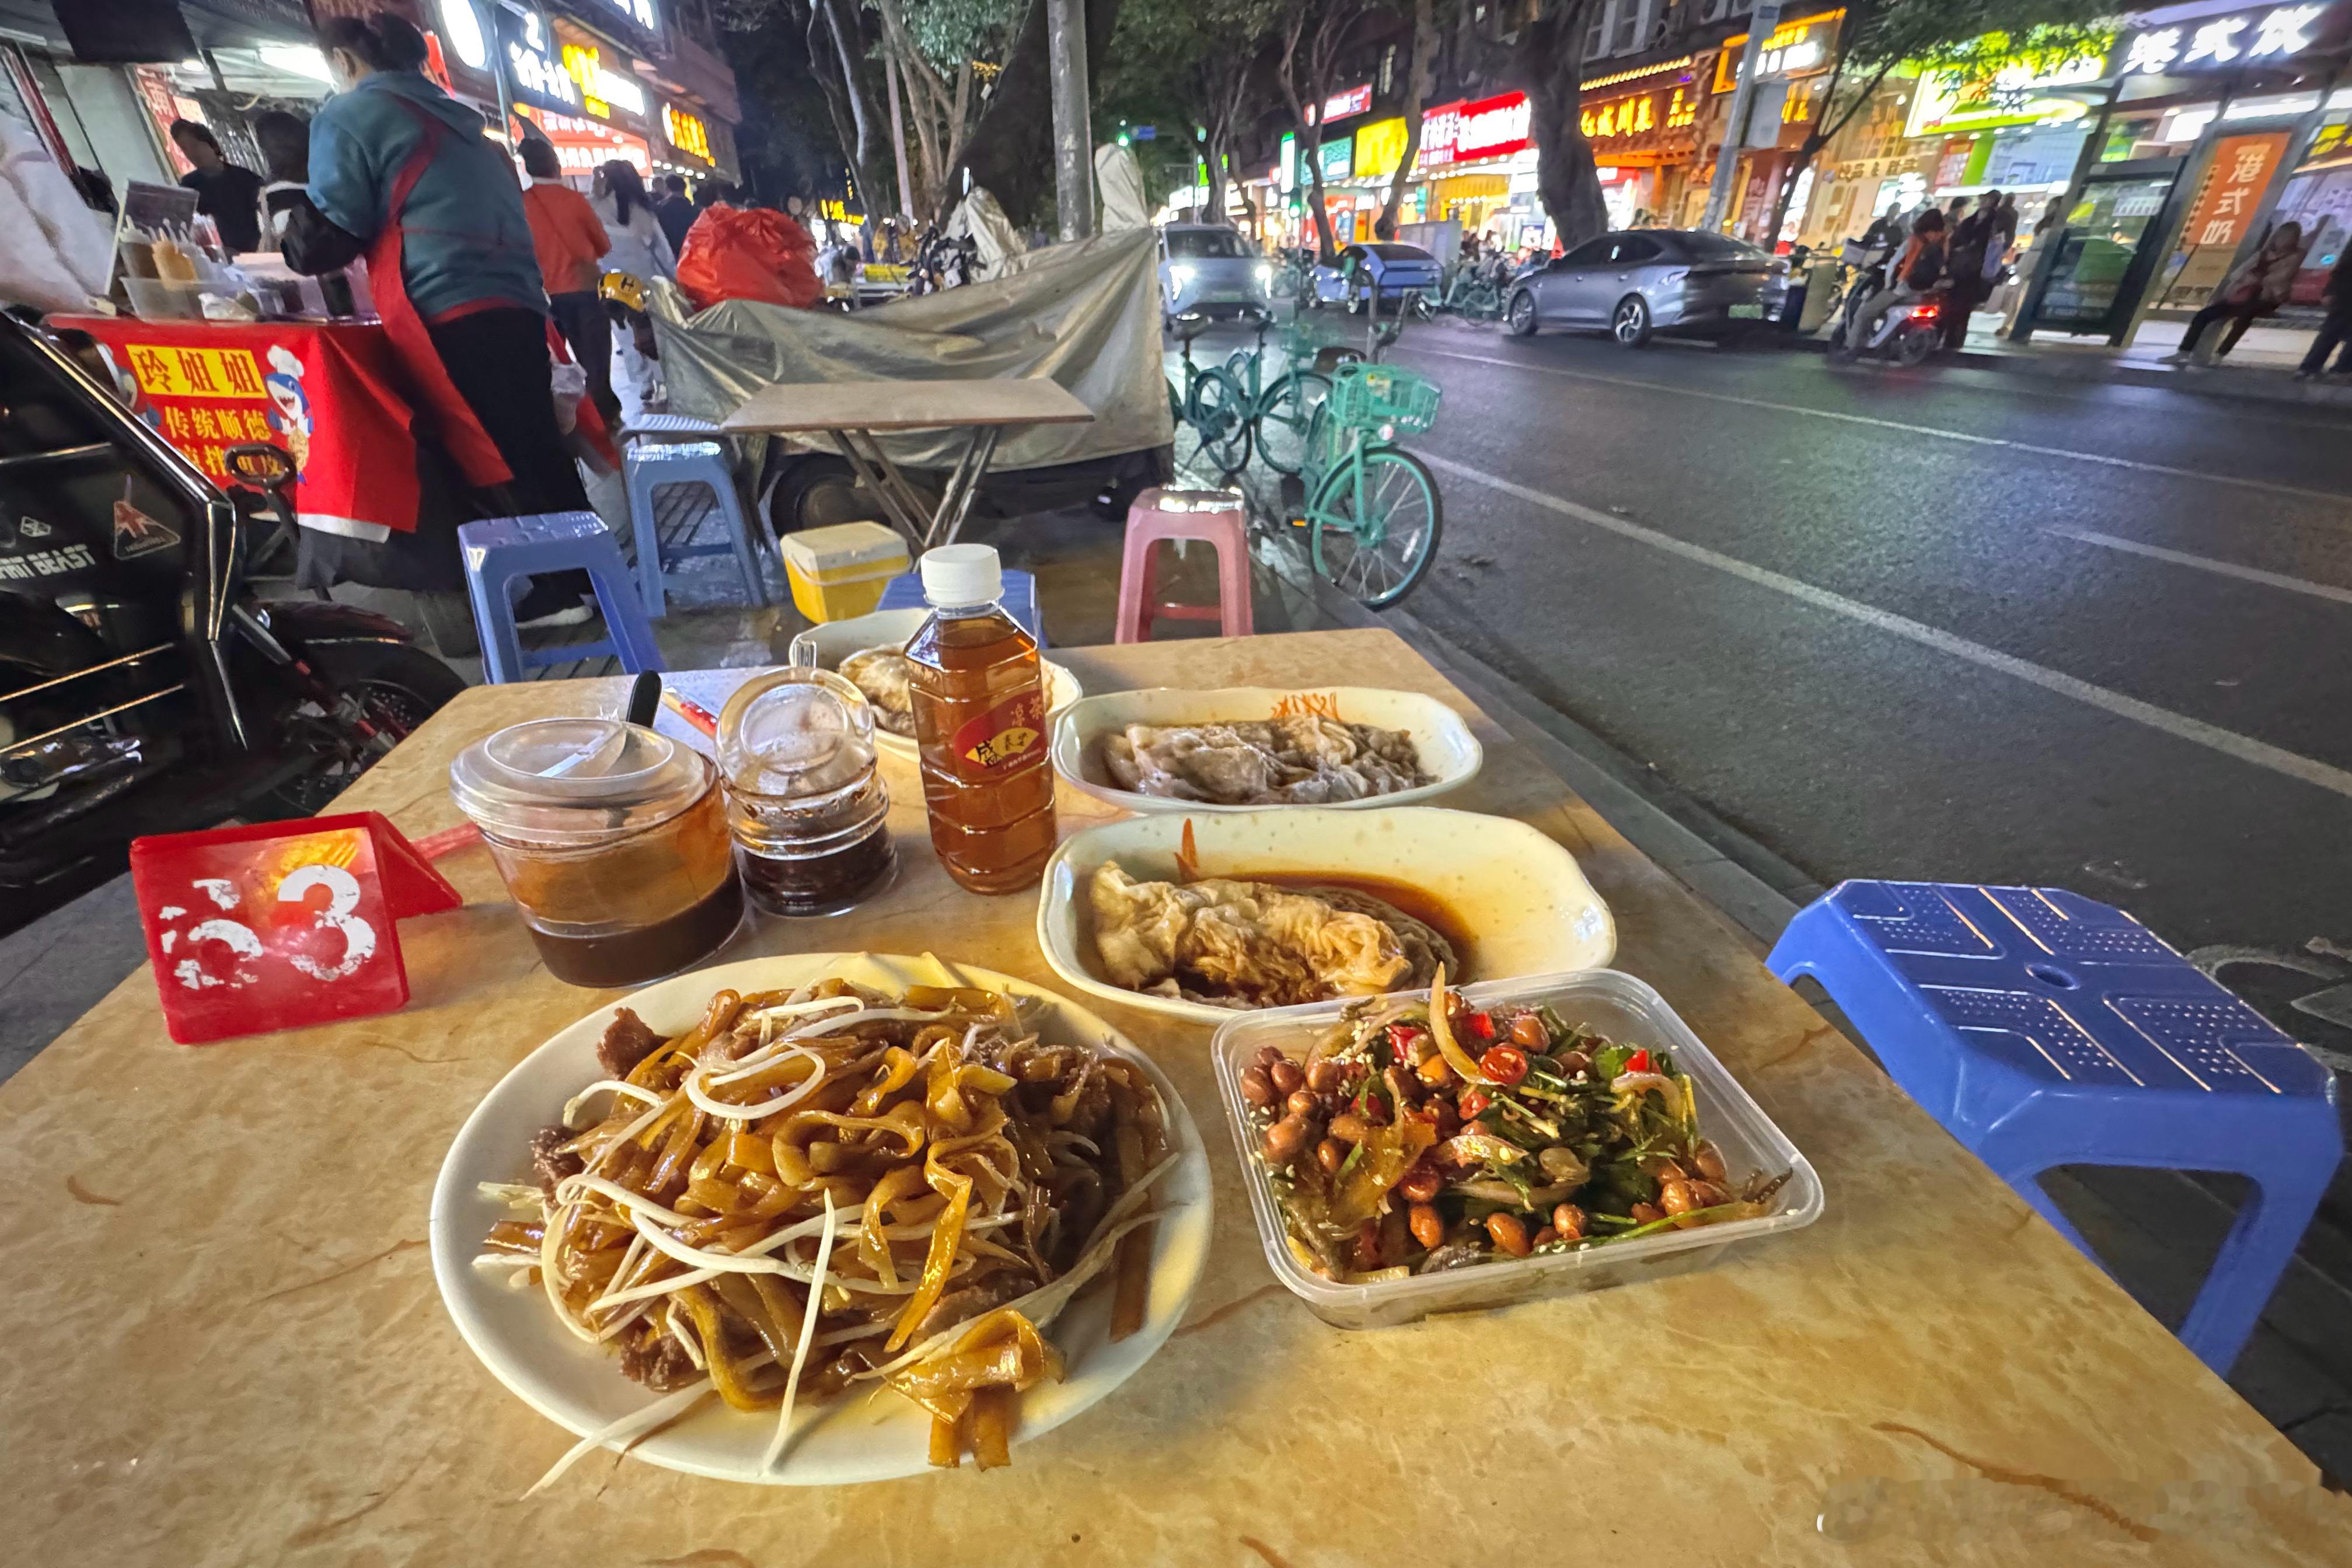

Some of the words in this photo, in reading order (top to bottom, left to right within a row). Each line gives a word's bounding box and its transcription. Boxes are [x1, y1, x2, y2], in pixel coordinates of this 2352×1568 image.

[133, 349, 262, 393] 玲姐姐
[165, 406, 272, 441] 传统顺德
[27, 543, 95, 575] BEAST
[1011, 696, 1042, 727] 凉茶
